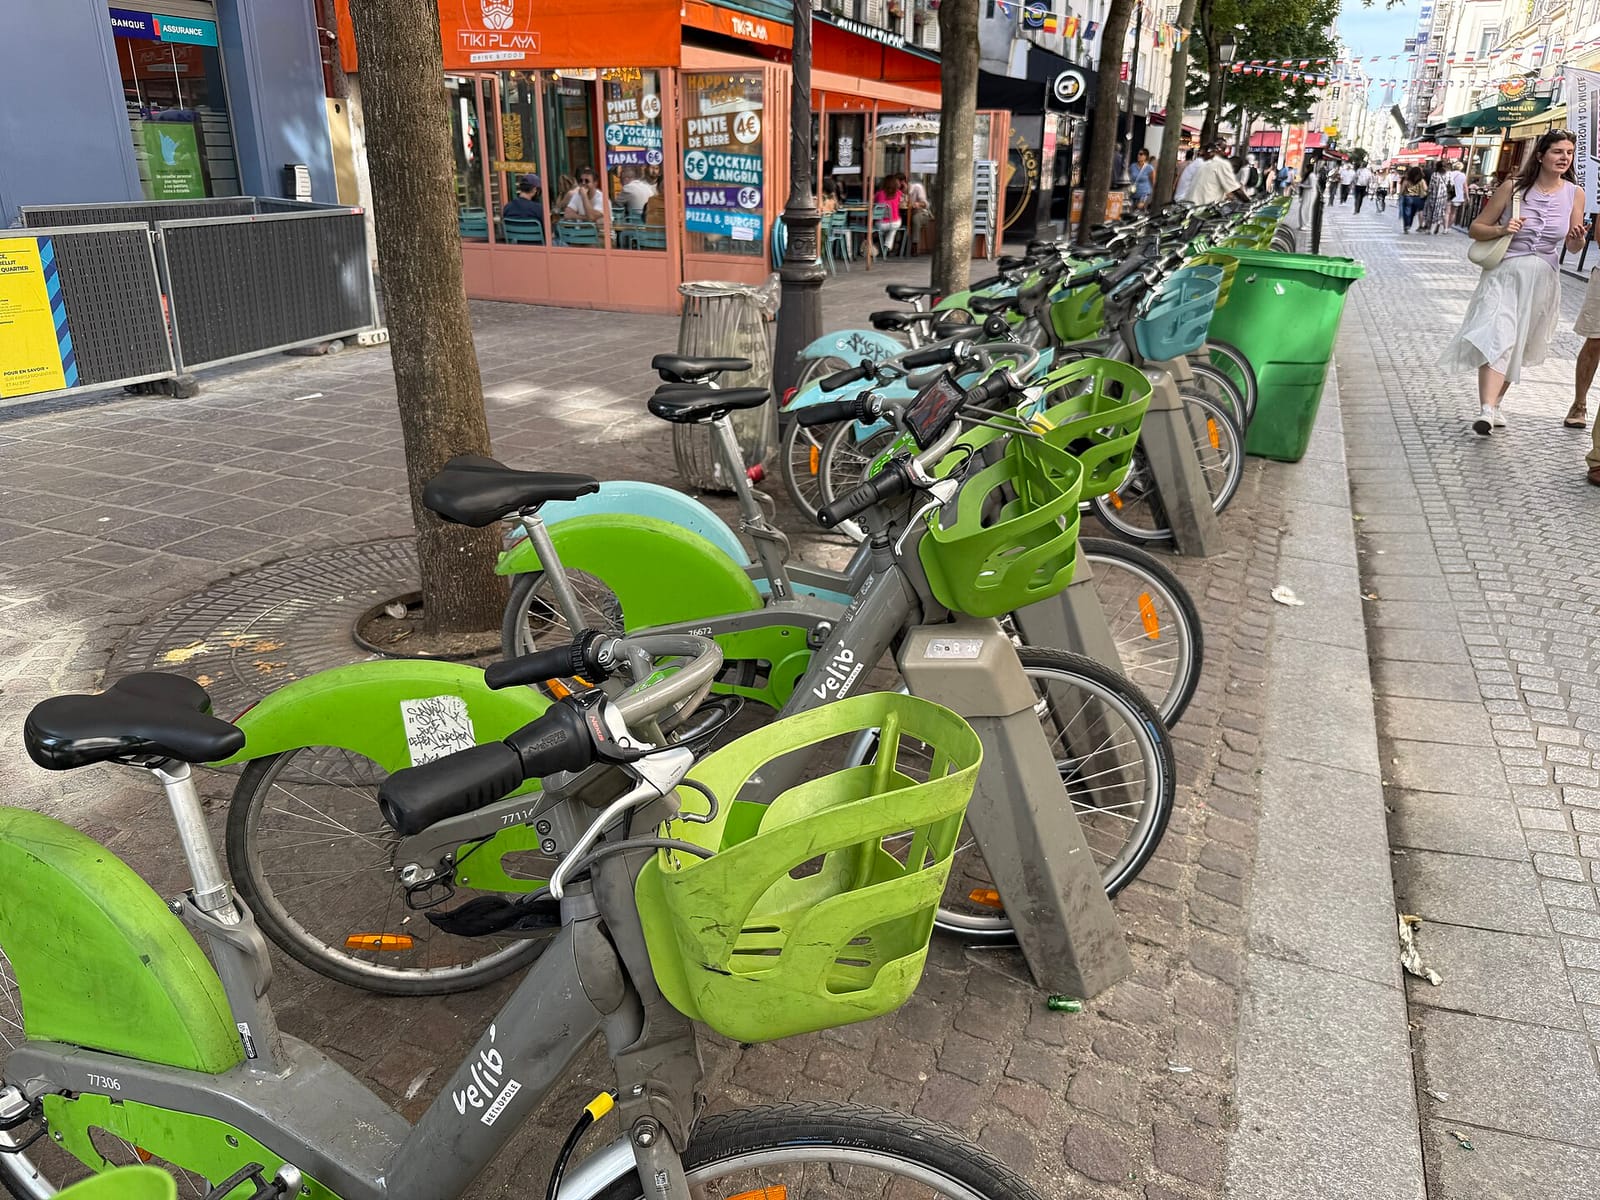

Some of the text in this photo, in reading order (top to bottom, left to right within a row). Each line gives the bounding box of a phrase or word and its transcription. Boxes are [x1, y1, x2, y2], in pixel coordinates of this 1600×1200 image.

[111, 18, 145, 30] BANQUE
[162, 24, 204, 36] ASSURANCE
[460, 33, 537, 49] TIKI PLAYA
[687, 75, 729, 89] HAPPY
[607, 98, 659, 114] PINTE 4€
[687, 115, 757, 137] PINTE 4€
[607, 129, 621, 142] 5€
[627, 137, 662, 147] SANGRIA
[688, 133, 730, 148] DE BIÈRE
[607, 153, 638, 165] TAPAS
[687, 154, 763, 176] 5€ COCKTAIL
[713, 168, 759, 185] SANGRIA
[686, 190, 758, 206] TAPAS 6€
[685, 211, 761, 229] PIZZA & BURGER
[1, 265, 29, 273] QUARTIER
[87, 1073, 121, 1091] 77306
